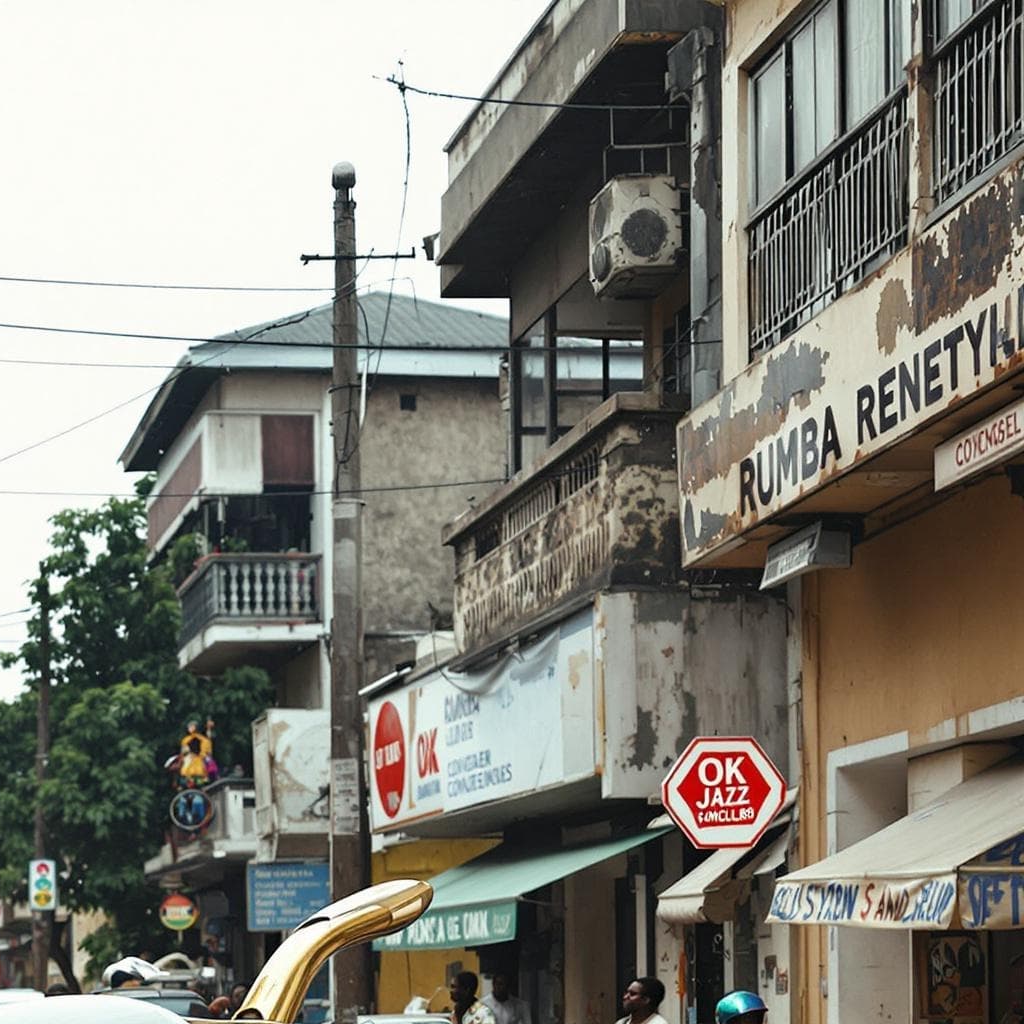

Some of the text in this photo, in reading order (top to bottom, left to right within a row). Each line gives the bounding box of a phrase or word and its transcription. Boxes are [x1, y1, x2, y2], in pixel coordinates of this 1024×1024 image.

[739, 405, 842, 517] RUMBA
[417, 727, 439, 779] OK
[698, 757, 747, 787] OK
[695, 786, 750, 809] JAZZ
